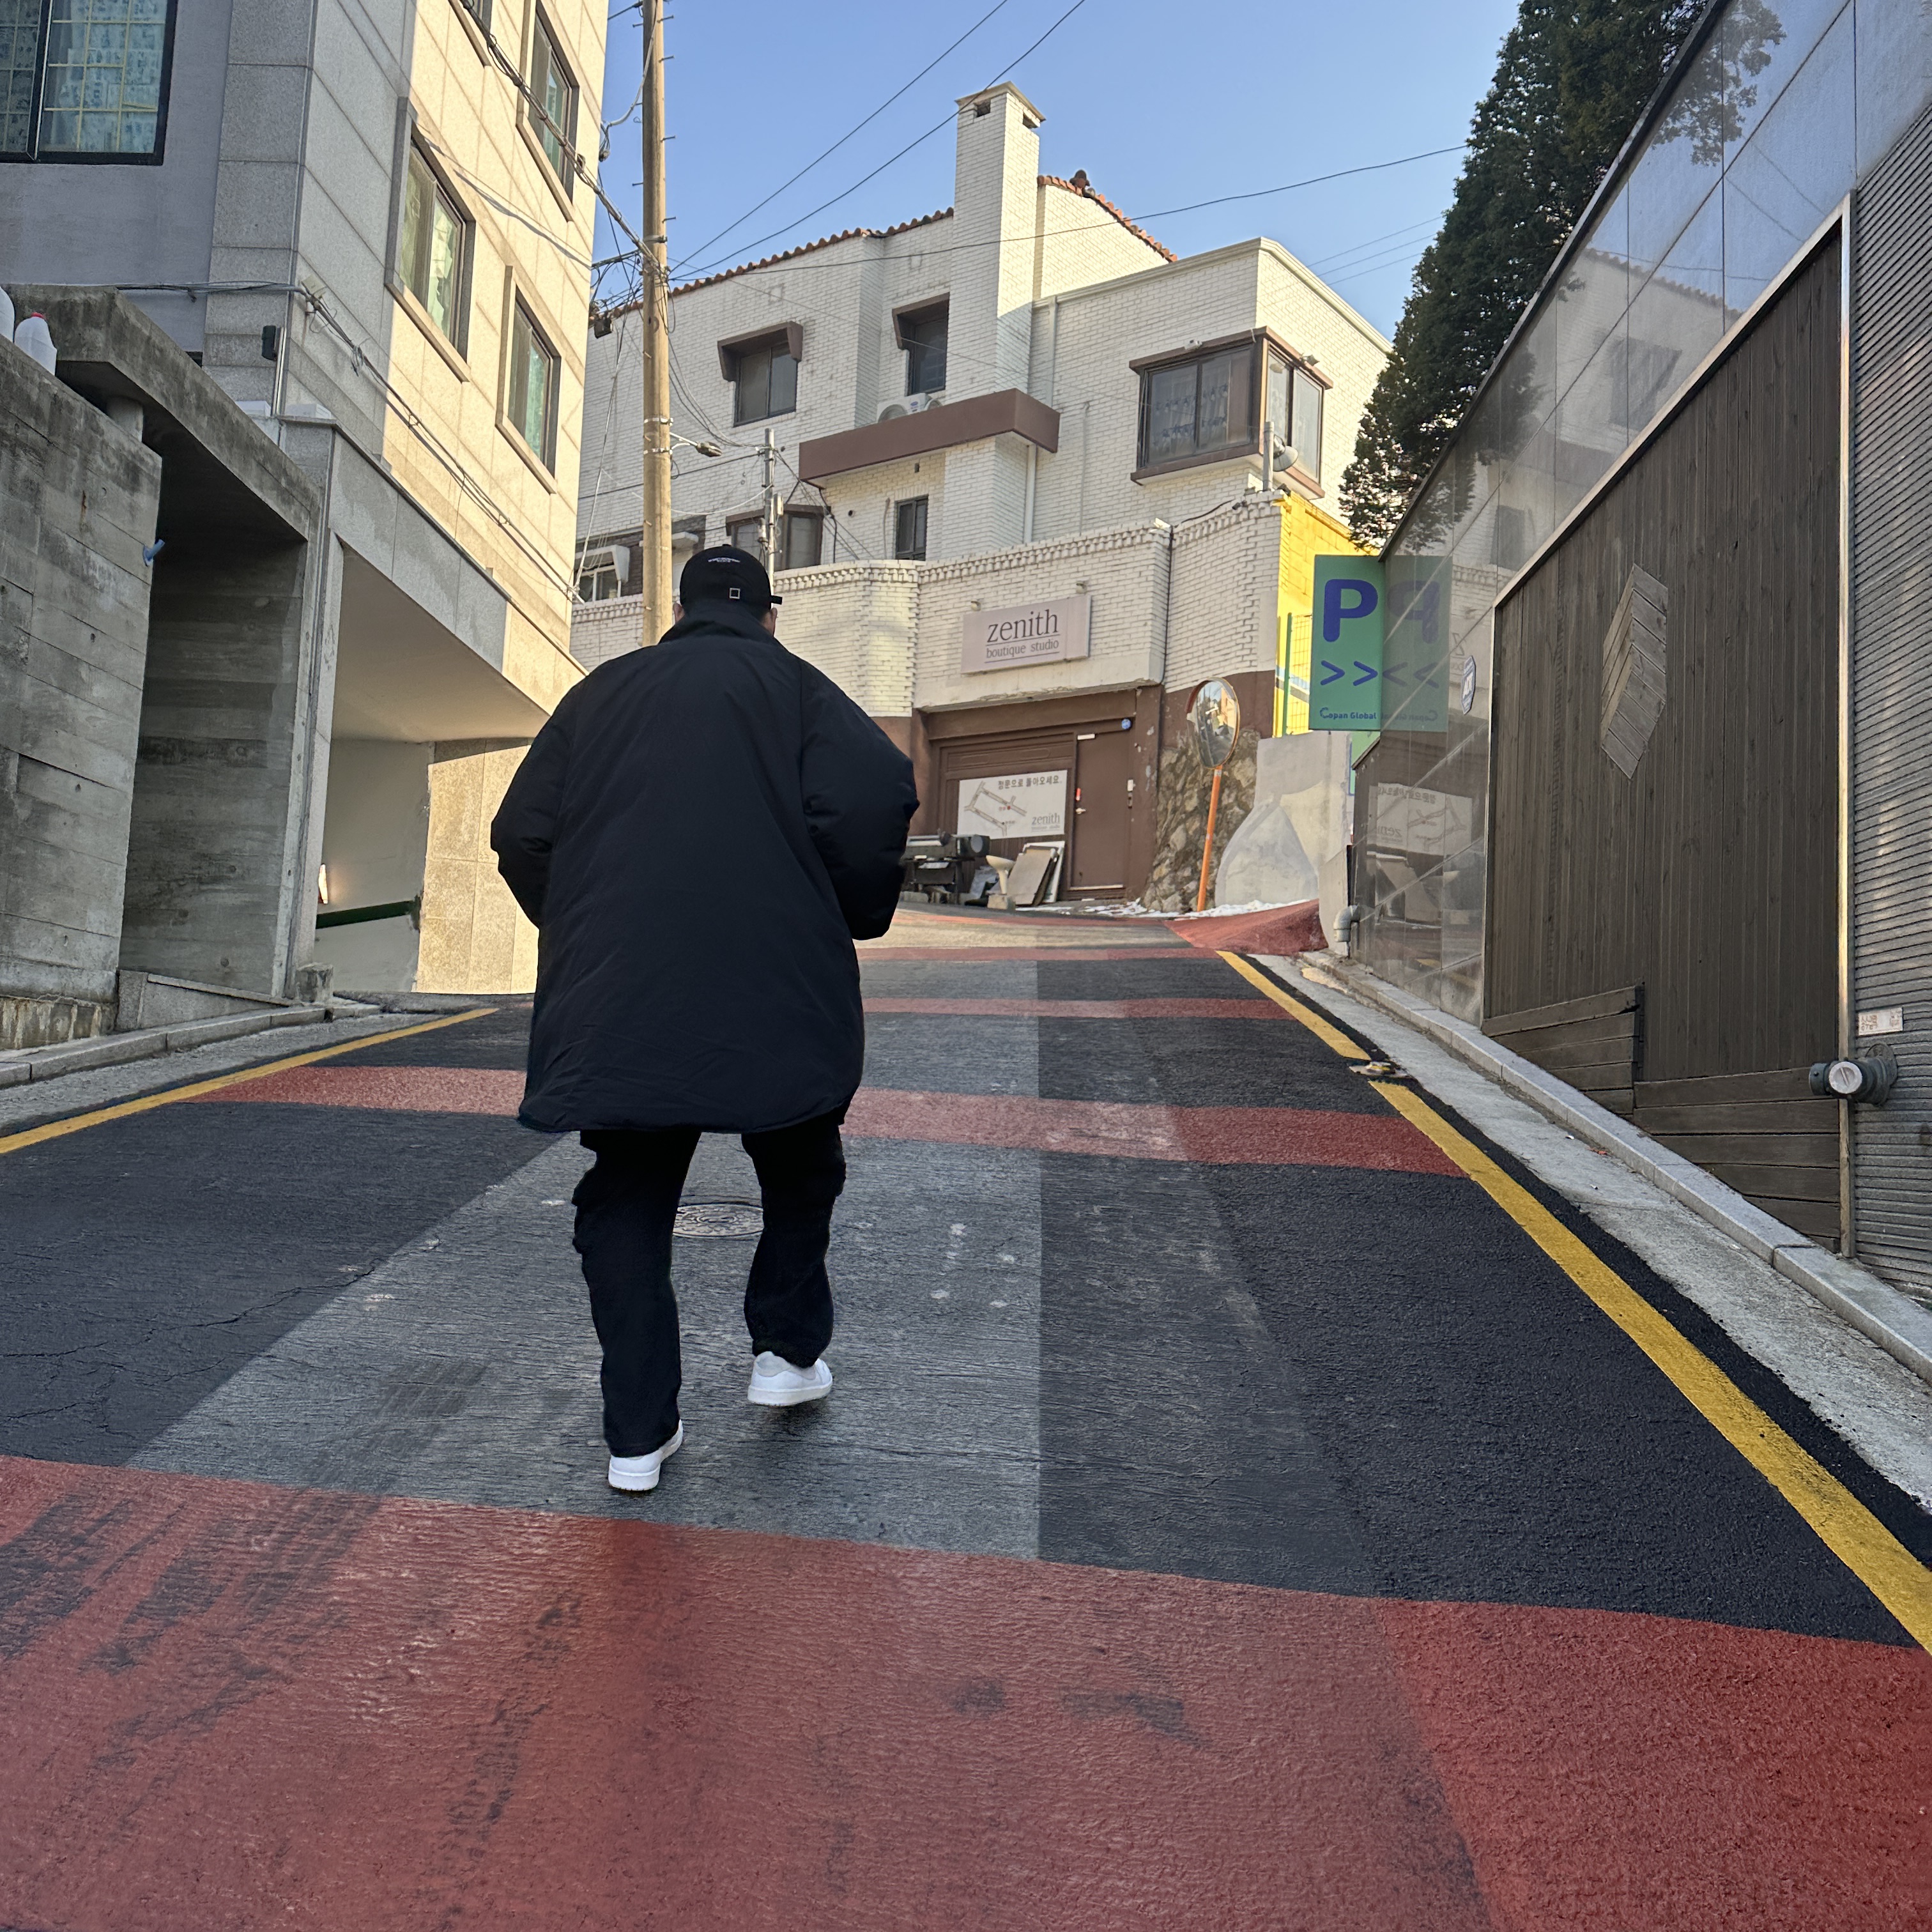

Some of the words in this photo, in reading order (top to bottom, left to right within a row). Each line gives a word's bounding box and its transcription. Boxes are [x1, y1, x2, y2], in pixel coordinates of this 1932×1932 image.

[1323, 579, 1378, 642] P
[987, 609, 1058, 643] zenith
[986, 645, 1026, 658] boutique
[1031, 639, 1059, 652] studio
[1319, 707, 1348, 719] Copan
[999, 779, 1023, 790] 정문으로
[1032, 813, 1060, 825] zenith
